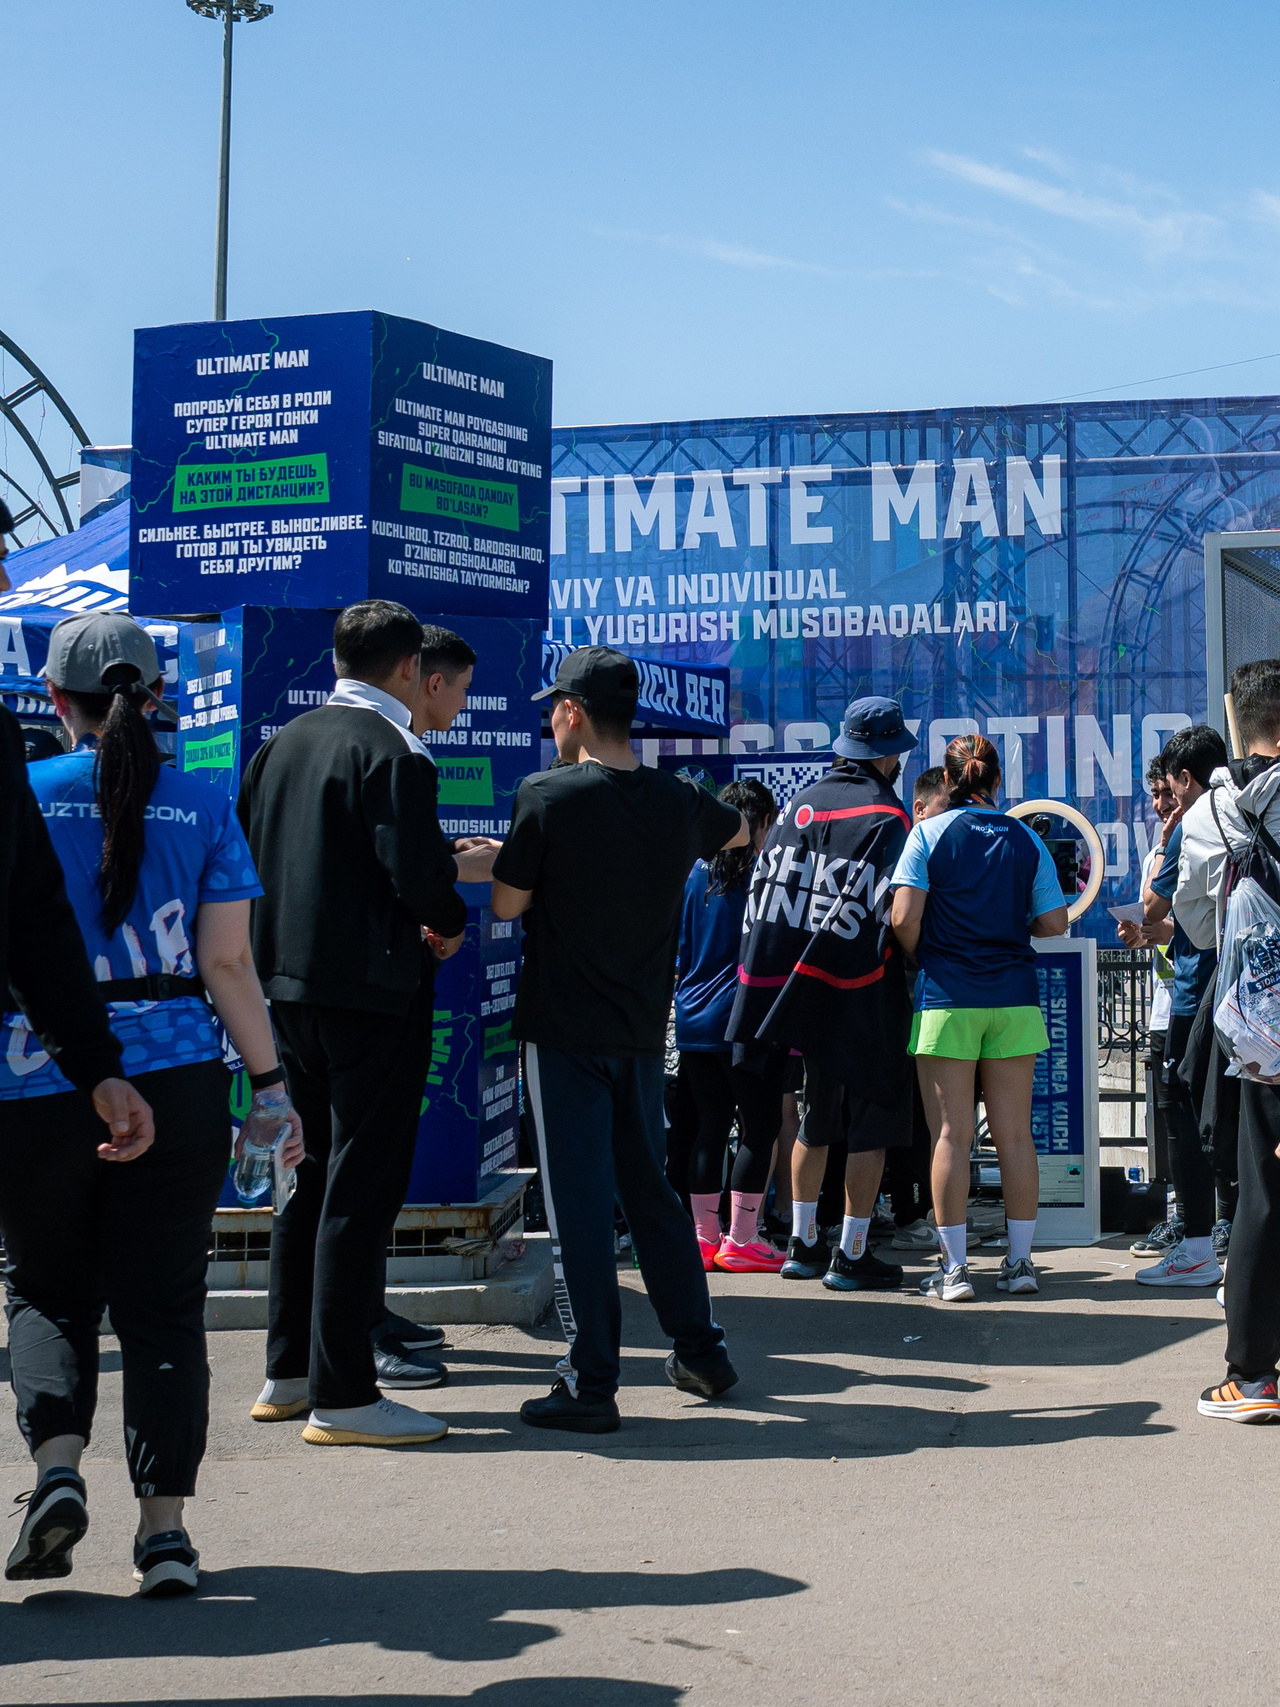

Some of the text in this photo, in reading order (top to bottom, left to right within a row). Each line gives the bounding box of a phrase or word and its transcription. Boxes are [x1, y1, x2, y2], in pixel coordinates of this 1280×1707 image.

[197, 350, 309, 375] ULTIMATE MAN
[423, 362, 504, 399] ULTIMATE MAN
[174, 391, 331, 417] ПОПРОБУЙ СЕБЯ В РОЛИ
[186, 409, 318, 434] СУПЕР ГЕРОЯ ГОНКИ
[395, 398, 528, 442] ULTIMATE MAN POYGASINING
[206, 429, 298, 450] ULTIMATE MAN
[378, 431, 422, 454] SIFATIDA
[477, 451, 504, 471] SINAB
[418, 422, 507, 455] SUPER QAHRAMONI
[188, 464, 317, 487] КАКИМ ТЫ БУДЕШЬ
[180, 481, 325, 505] НА ЭТОЙ ДИСТАНЦИИ?
[409, 473, 514, 507] BU MASOFADA QANDAY
[872, 454, 1062, 541] MAN
[139, 515, 367, 543] СИЛЬНЕЕ. БЫСТРЕЕ. ВЫНОСЛИВЕЕ.
[372, 520, 545, 564] KUCHLIROQ. TEZROQ. BARDOSHLIROQ.
[176, 535, 327, 558] ГОТОВ ЛИ ТЫ УВИДЕТЬ
[200, 555, 302, 575] СЕБЯ ДРУГИМ?
[449, 552, 516, 575] BOSHQALARGA
[461, 571, 530, 594] TAYYORMISAN?
[549, 568, 847, 610] VIY VA INDIVIDUAL
[584, 609, 741, 645] YUGURISH
[752, 600, 1007, 641] MUSOBAQALARI
[685, 672, 726, 727] BER
[421, 730, 468, 745] SINAB
[1050, 967, 1069, 1151] HISSIYOTINGA KUCH
